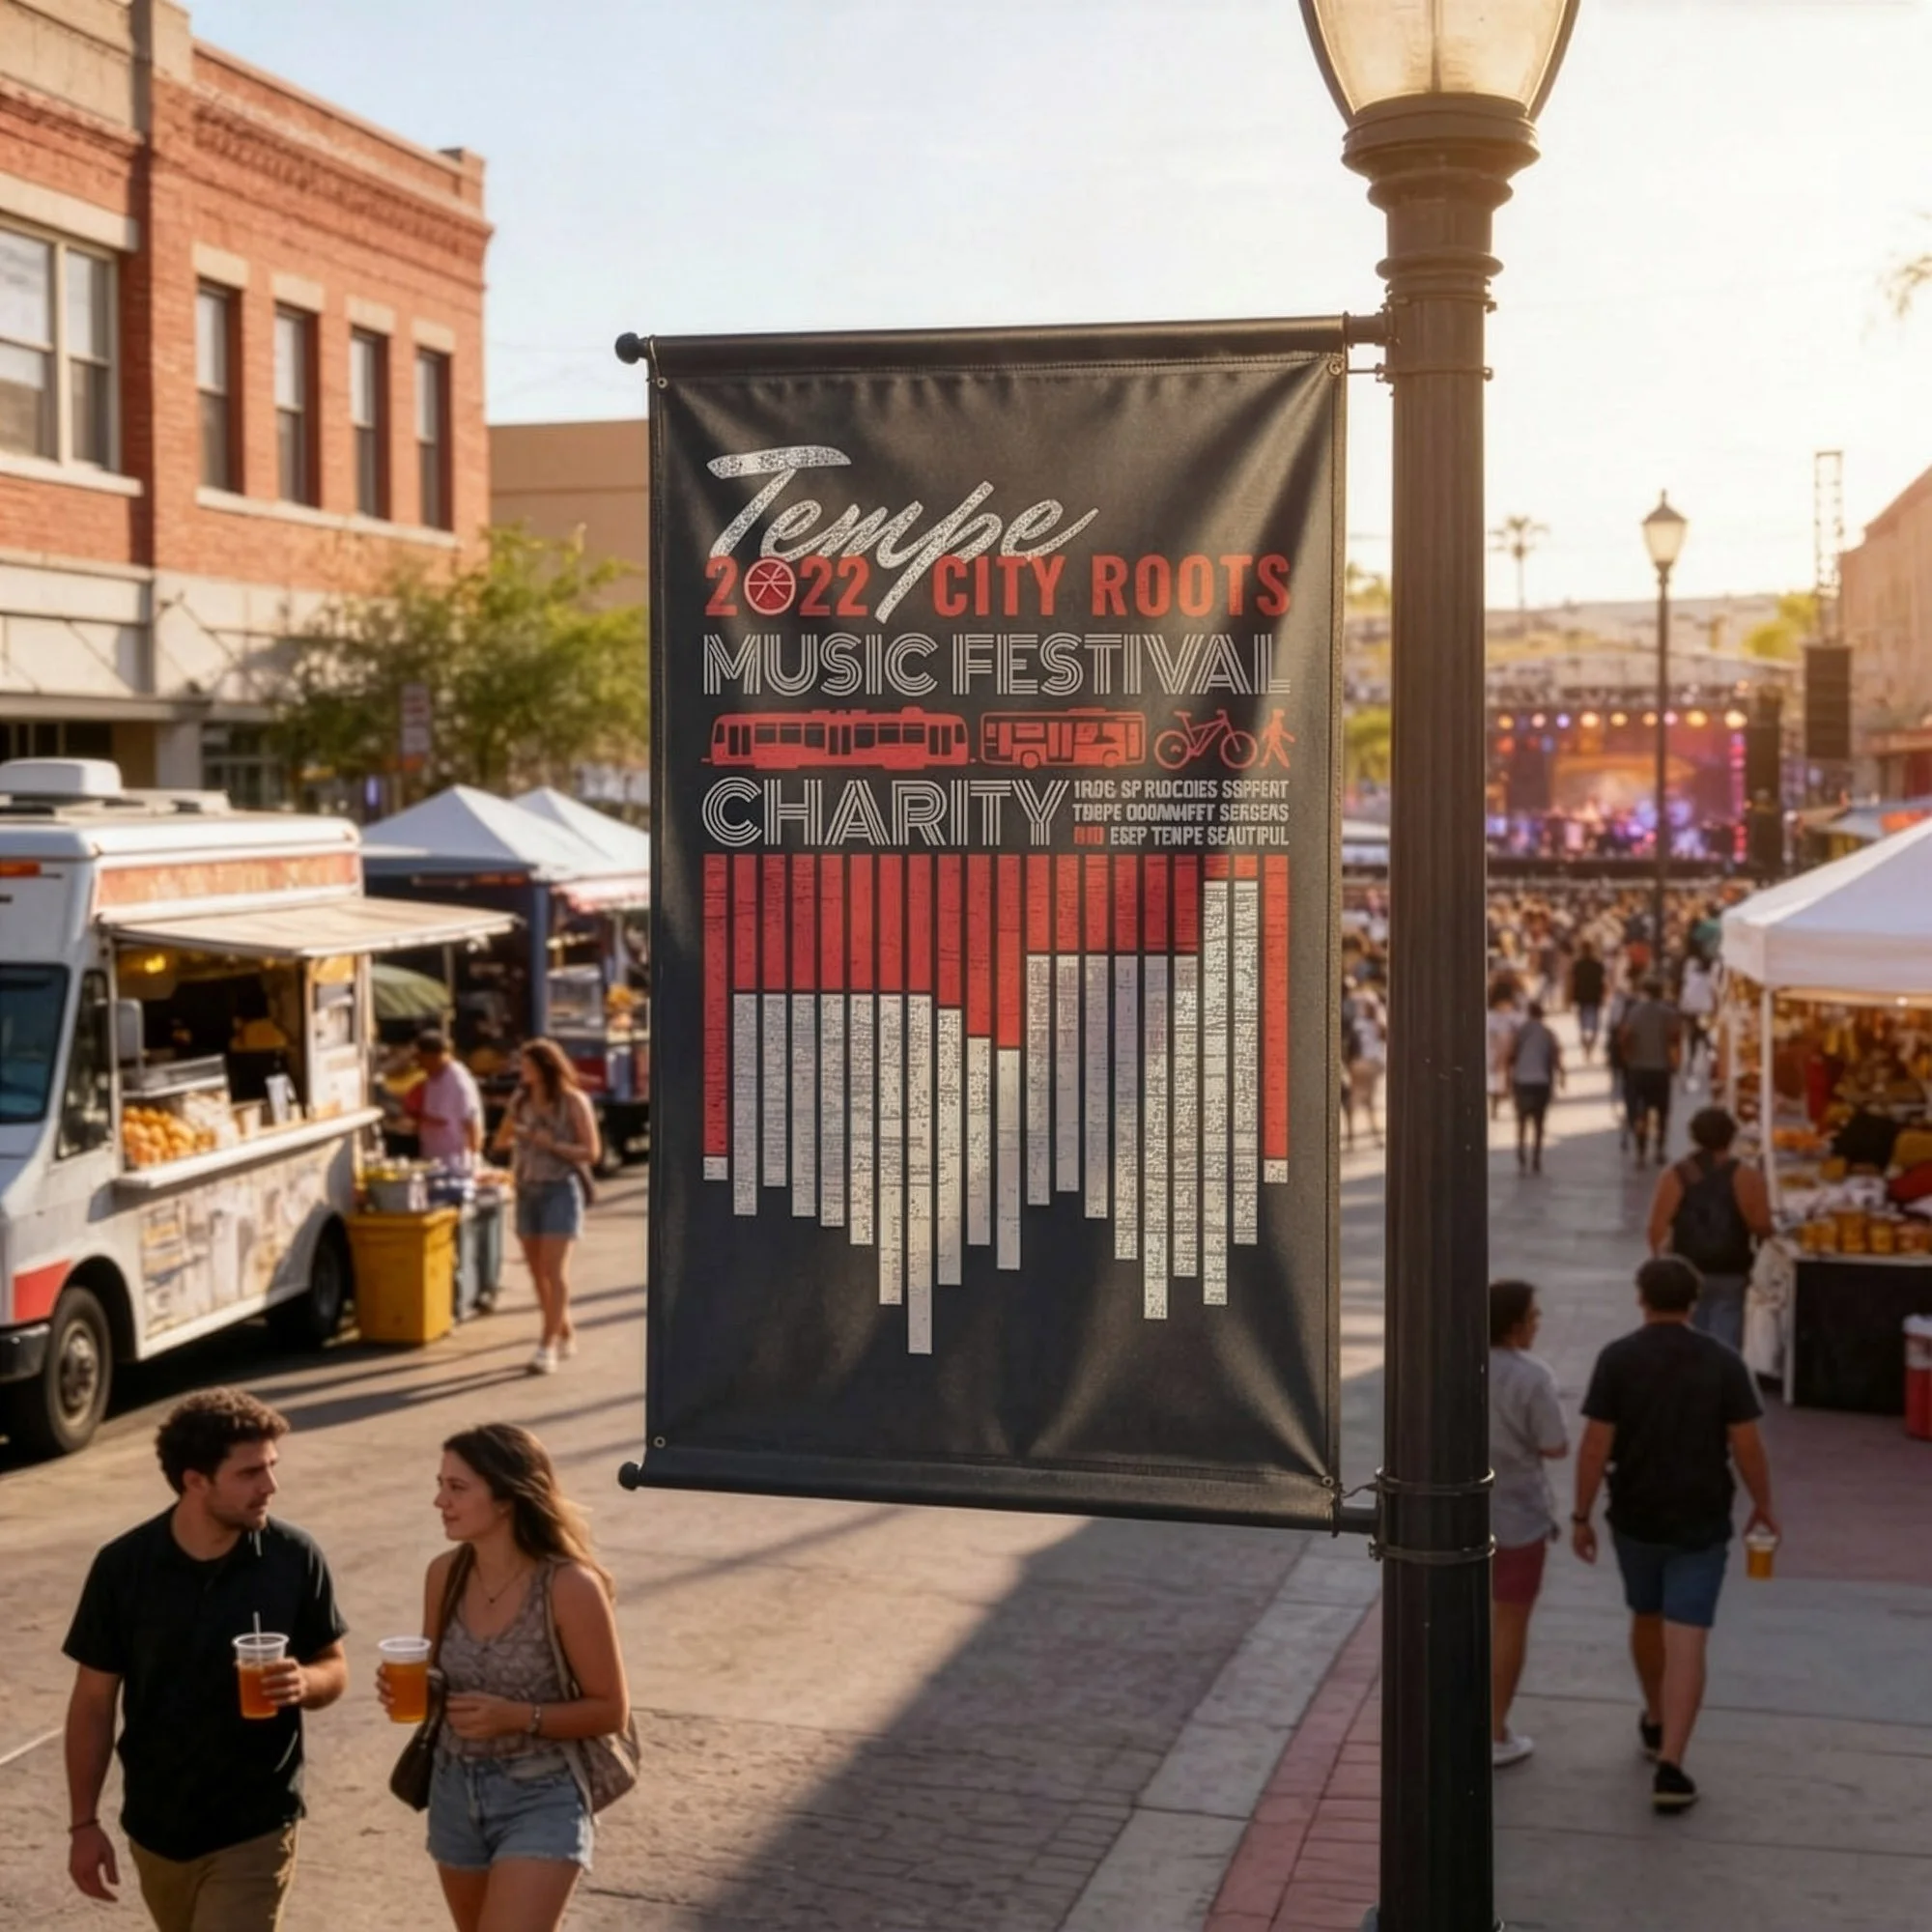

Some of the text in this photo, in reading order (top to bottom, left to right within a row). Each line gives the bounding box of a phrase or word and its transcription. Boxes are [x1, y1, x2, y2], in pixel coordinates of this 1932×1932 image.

[706, 444, 1099, 623] Tempe
[932, 554, 1065, 616] CITY
[1092, 554, 1292, 616] ROOTS
[702, 632, 1292, 696] MUSIC FESTIVAL
[700, 777, 1070, 846] CHARITY
